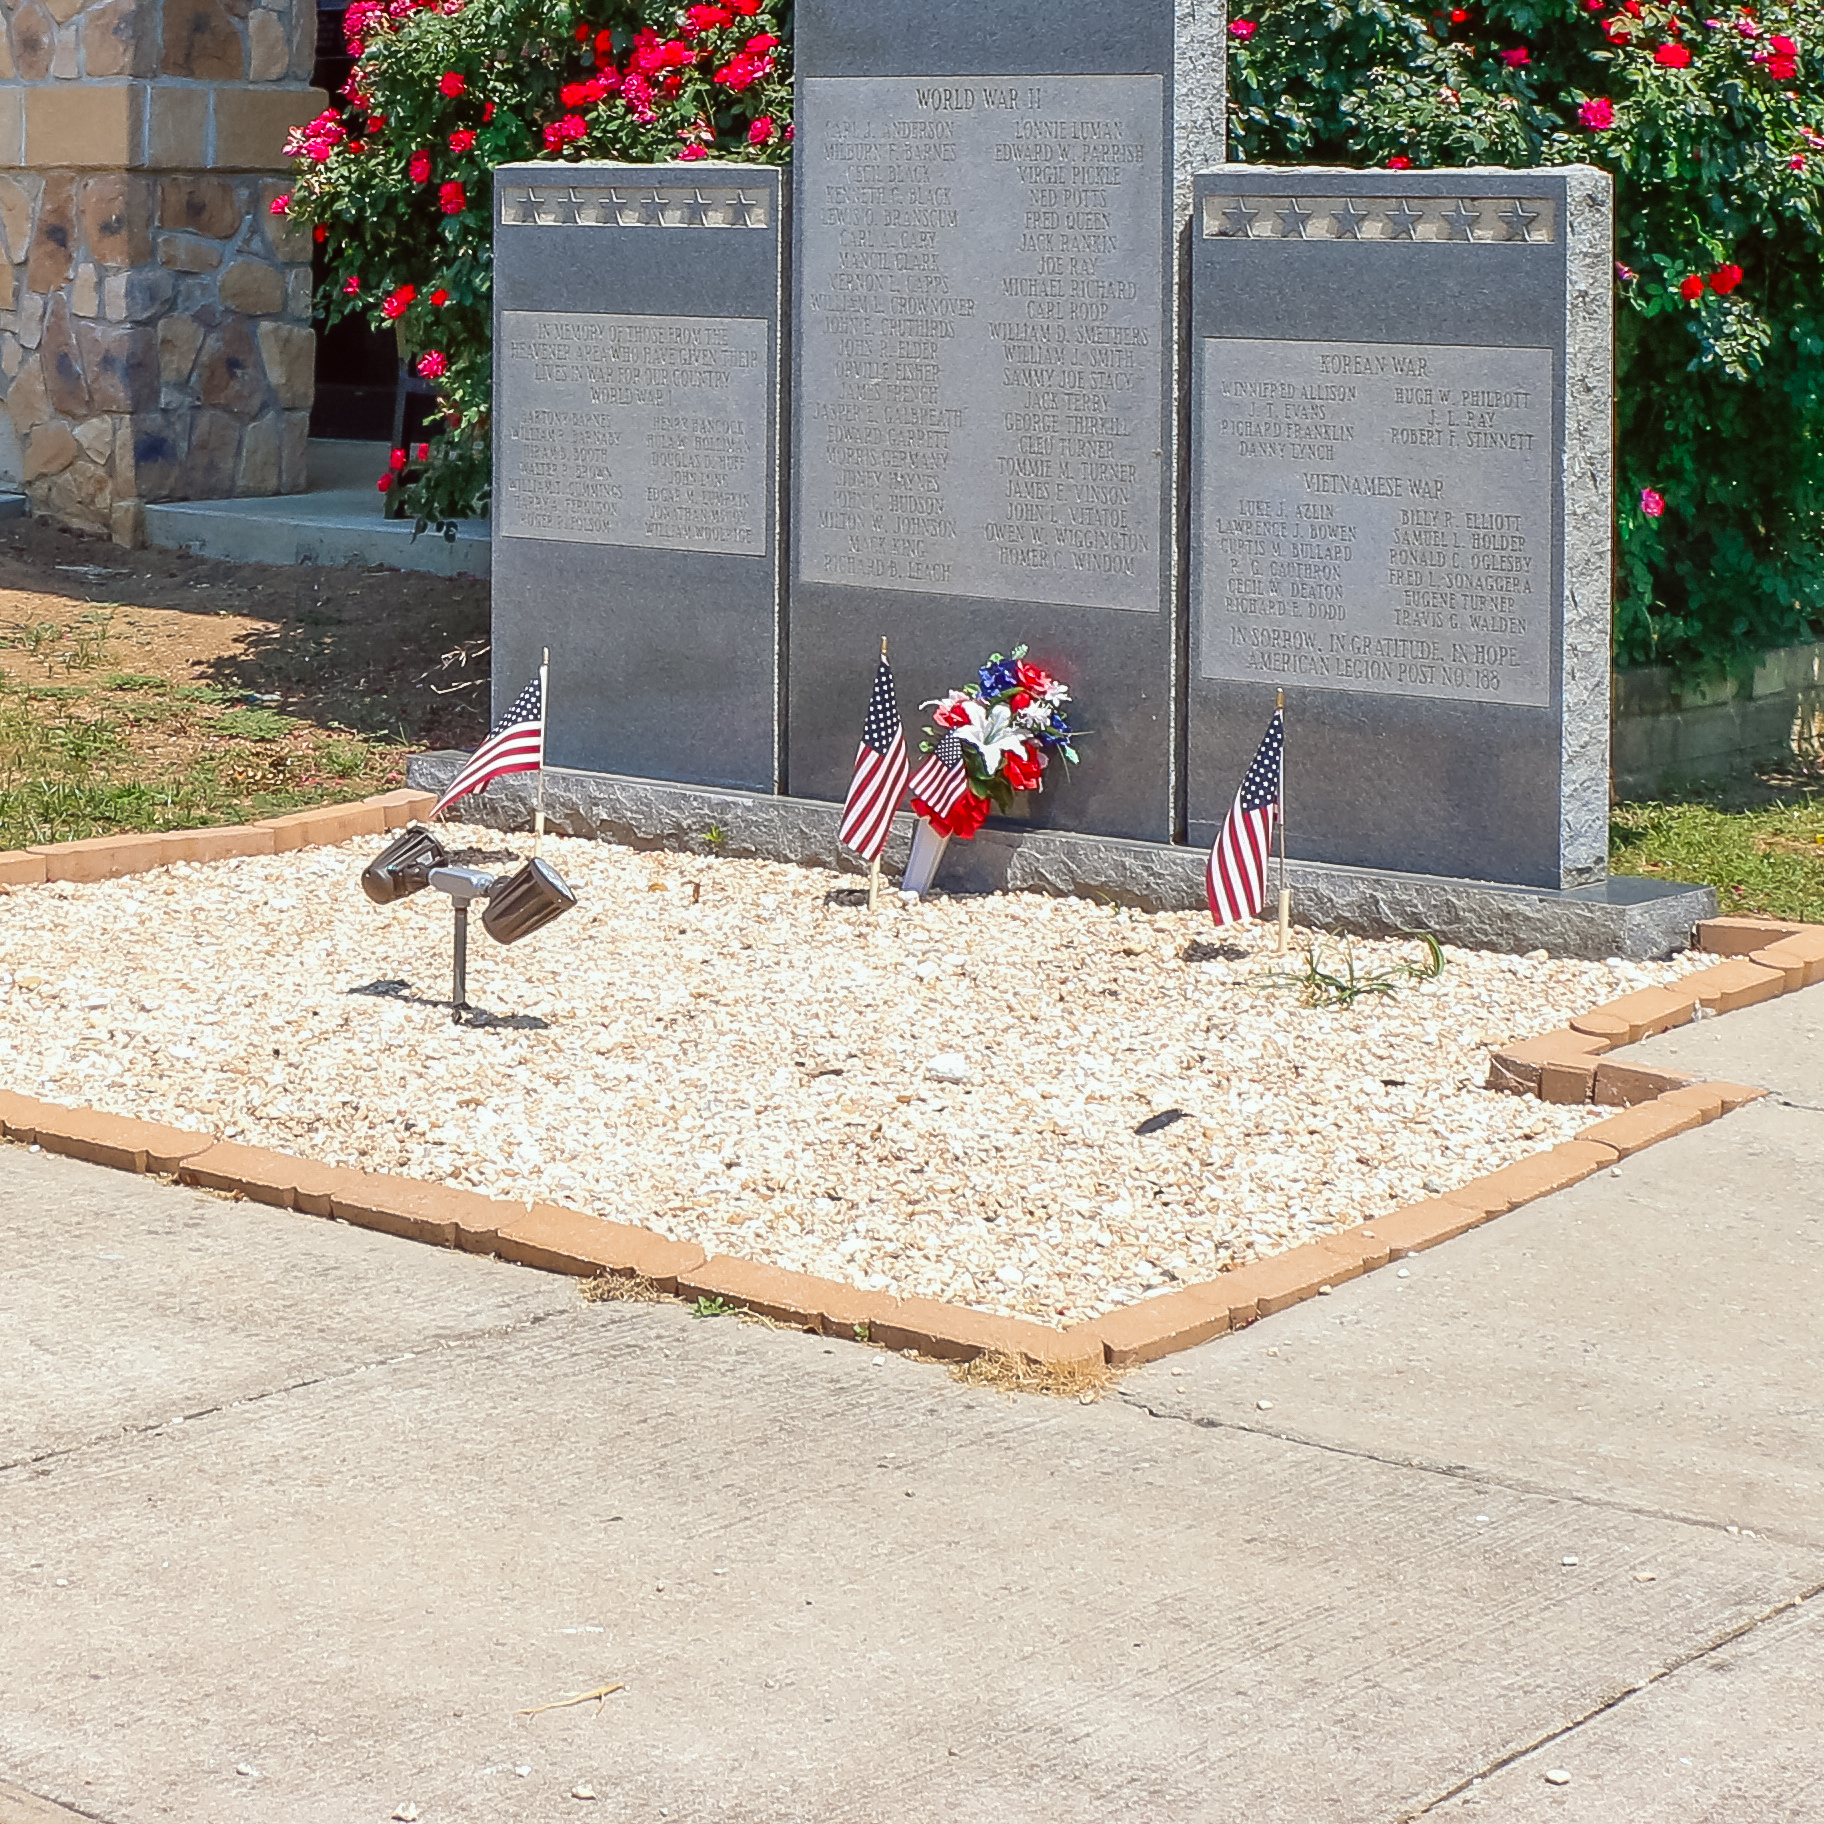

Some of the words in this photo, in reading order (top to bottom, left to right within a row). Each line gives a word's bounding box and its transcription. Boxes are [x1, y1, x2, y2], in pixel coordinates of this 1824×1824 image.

[916, 88, 974, 110] WORLD
[983, 87, 1017, 110] WAR
[1015, 121, 1066, 139] LONNIE
[1071, 121, 1122, 139] LUMAN
[995, 143, 1052, 161] EDWARD
[1082, 143, 1143, 162] PARRISH
[1017, 165, 1065, 184] VIRGIL
[1072, 166, 1120, 184] PICKLE
[1029, 188, 1056, 207] NED
[1063, 189, 1106, 207] POTTS
[1025, 211, 1059, 229] FRED
[1066, 211, 1110, 230] QUEEN
[1018, 233, 1053, 251] JACK
[1060, 234, 1116, 253] RANKIN
[1037, 256, 1063, 275] JOE
[1070, 256, 1097, 275] RAY
[1002, 277, 1064, 297] MICHAEL
[1070, 279, 1136, 299] RICHARD
[1026, 300, 1063, 319] CARL
[988, 322, 1050, 342] WILLIAM
[1002, 344, 1064, 365] WILLIAM
[1089, 348, 1133, 368] SMITH
[1319, 354, 1384, 375] KOREAN
[1391, 357, 1430, 377] WAR
[1003, 367, 1054, 388] SAMMY
[1058, 369, 1084, 389] JOE
[1090, 370, 1134, 391] STACY
[589, 386, 632, 404] WORLD
[635, 388, 663, 406] WAR
[1024, 390, 1058, 409] JACK
[1064, 392, 1107, 412] TERRY
[1300, 384, 1355, 401] ALLISON
[1395, 387, 1432, 404] HUGH
[1461, 390, 1531, 408] PHILPOTT
[1005, 412, 1058, 433] GEORGE
[1284, 403, 1325, 420] EVANS
[1465, 410, 1494, 428] RAY
[1221, 419, 1280, 438] RICHARD
[1286, 422, 1353, 441] FRANKLIN
[1390, 427, 1442, 446] ROBERT
[1466, 431, 1534, 450] STINNETT
[1059, 437, 1113, 458] TURNER
[1239, 440, 1286, 458] DANNY
[1291, 443, 1333, 460] LYNCH
[996, 456, 1051, 477] TOMMIE
[1080, 461, 1135, 482] TURNER
[1005, 479, 1049, 500] JAMES
[1074, 484, 1128, 505] VINSON
[1303, 473, 1402, 497] VIETNAMESE
[1407, 478, 1444, 499] WAR
[1006, 502, 1043, 522] JOHN
[1400, 508, 1439, 526] BILLY
[1465, 512, 1520, 531] ELLIOTT
[985, 522, 1023, 543] OWEN
[1216, 517, 1286, 537] LAWRENCE
[1309, 523, 1356, 541] BOWEN
[1393, 528, 1448, 547] SAMUEL
[1471, 533, 1525, 552] HOLDER
[999, 546, 1047, 567] HOMER
[1072, 551, 1134, 574] WINDOM
[1220, 537, 1265, 555] CURTIS
[1291, 542, 1351, 561] BULLARD
[1389, 548, 1445, 567] RONALD
[1471, 553, 1531, 573] OGLESBY
[1387, 568, 1422, 586] FRED
[1228, 577, 1263, 595] CECIL
[1290, 581, 1342, 601] DEATON
[1224, 596, 1285, 616] RICHARD
[1308, 602, 1345, 621] DODD
[1403, 589, 1455, 609] EUGENE
[1461, 593, 1514, 613] TURNER
[1393, 608, 1442, 628] TRAVIS
[1469, 614, 1525, 634] WALDEN
[1230, 625, 1246, 645] IN
[1329, 633, 1345, 653] IN
[1451, 642, 1468, 663] IN
[1246, 650, 1329, 676] AMERICAN
[1336, 657, 1391, 681] LEGION
[1397, 662, 1435, 684] POST
